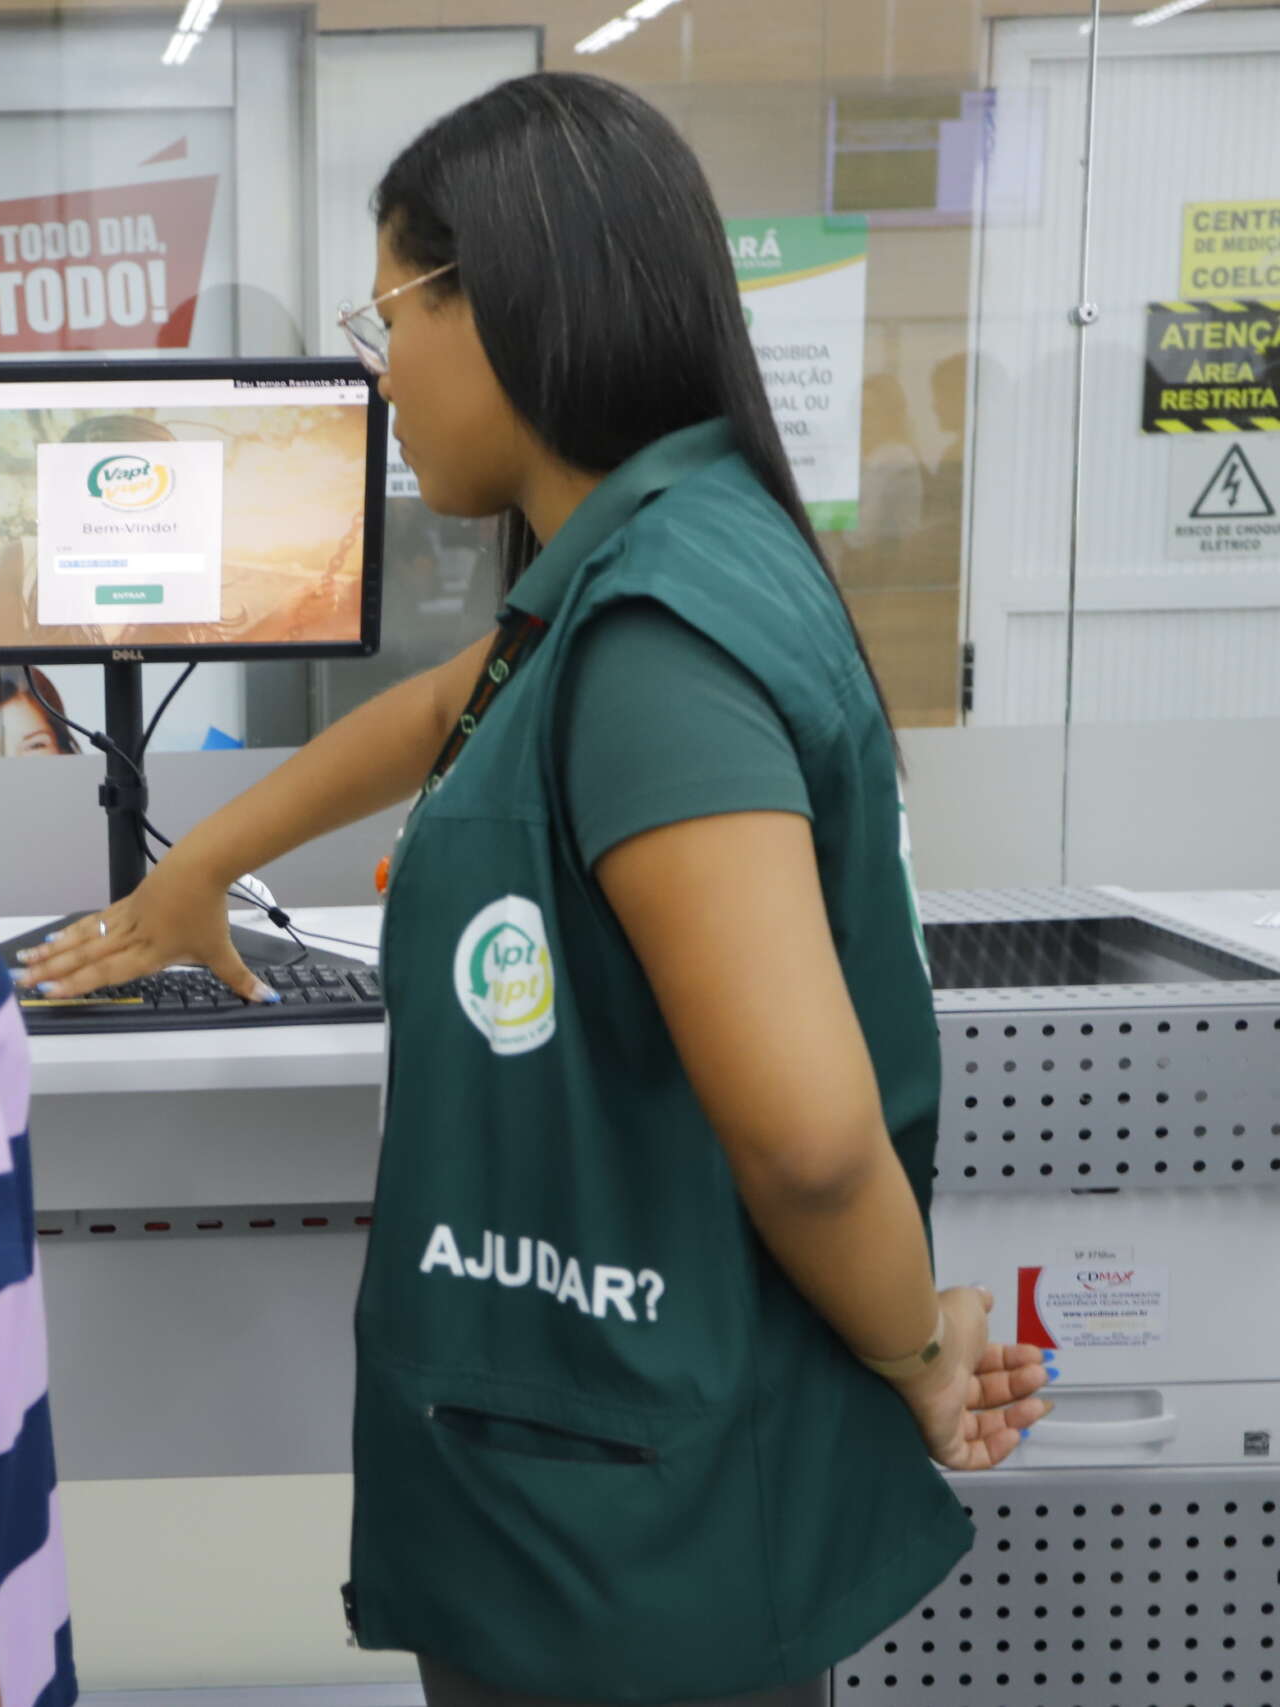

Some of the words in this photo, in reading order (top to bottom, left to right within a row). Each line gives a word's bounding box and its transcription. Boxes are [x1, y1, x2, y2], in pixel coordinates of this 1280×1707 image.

[1194, 237, 1216, 253] DE
[1186, 358, 1255, 384] ÁREA
[805, 395, 830, 410] OU
[1160, 388, 1278, 410] RESTRITA
[104, 463, 151, 482] Vapt
[82, 523, 177, 535] Bem-Vindo!
[111, 650, 144, 661] DELL
[419, 1223, 665, 1322] AJUDAR?
